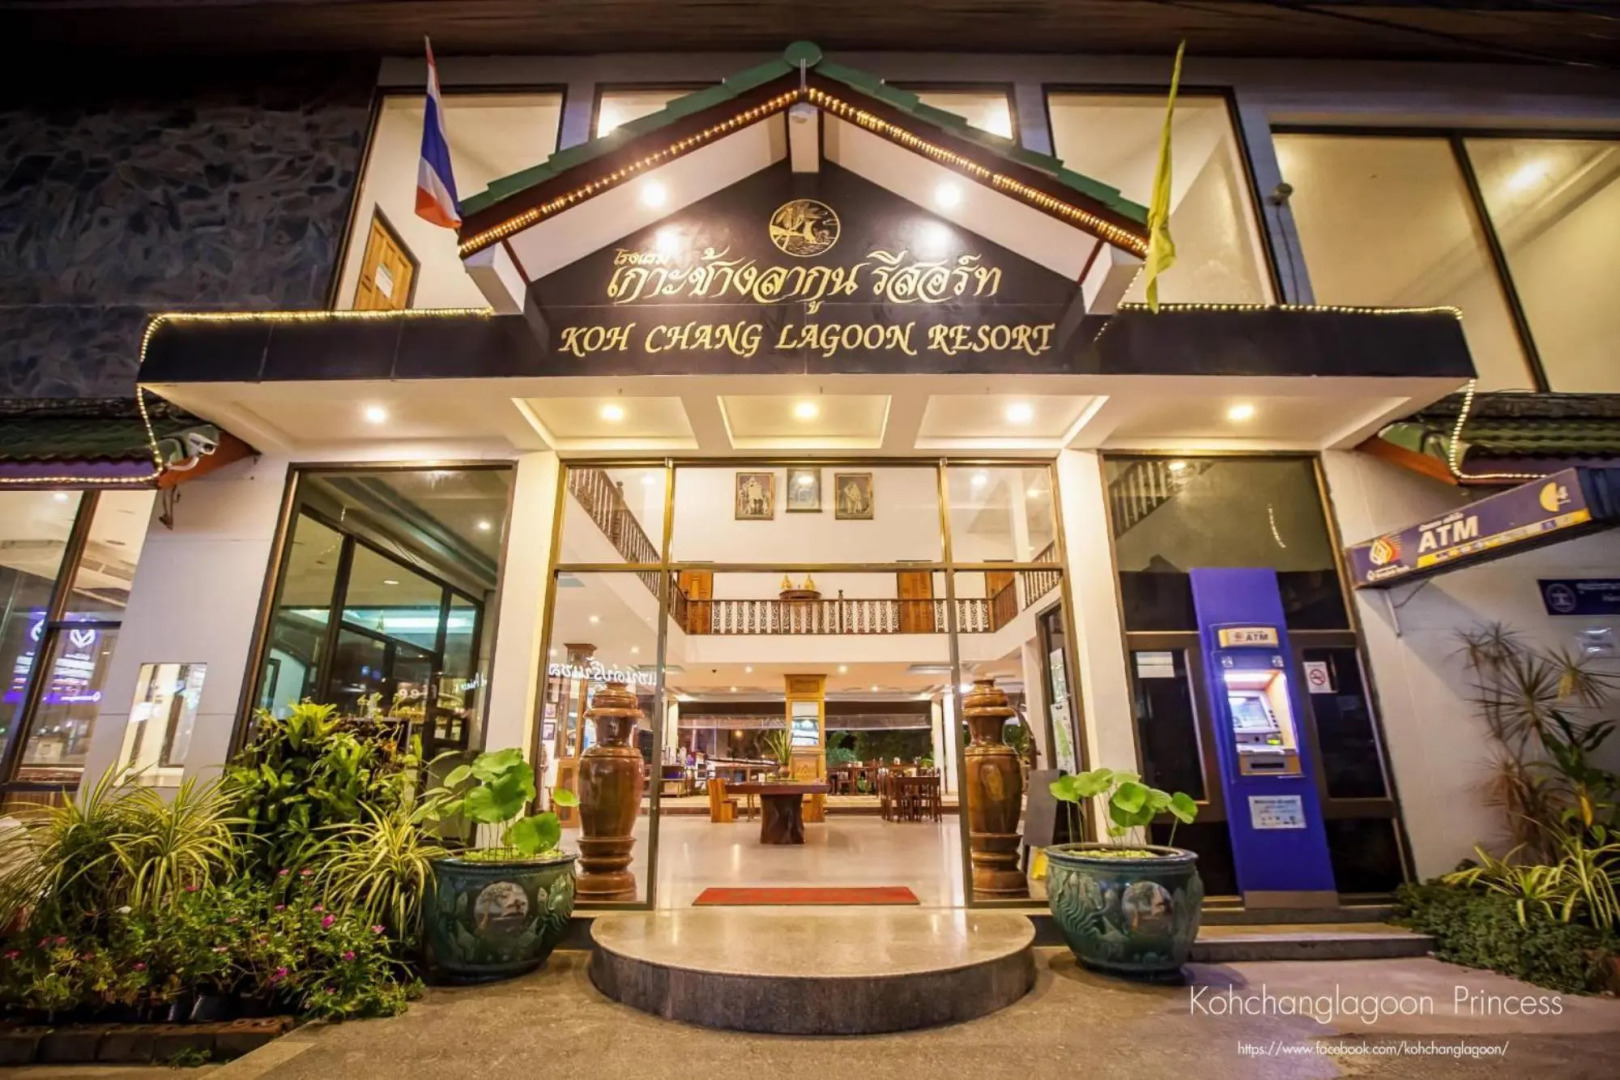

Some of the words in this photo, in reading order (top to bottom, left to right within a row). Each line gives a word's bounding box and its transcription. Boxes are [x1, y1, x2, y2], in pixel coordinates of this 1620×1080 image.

[606, 246, 873, 314] เกาะช้างลากูน
[866, 250, 1003, 304] รีสอร์ท
[558, 321, 635, 357] KOH
[645, 321, 764, 357] CHANG
[774, 321, 919, 358] LAGOON
[928, 322, 1056, 357] RESORT
[1417, 515, 1479, 553] ATM
[1246, 633, 1269, 641] ATM
